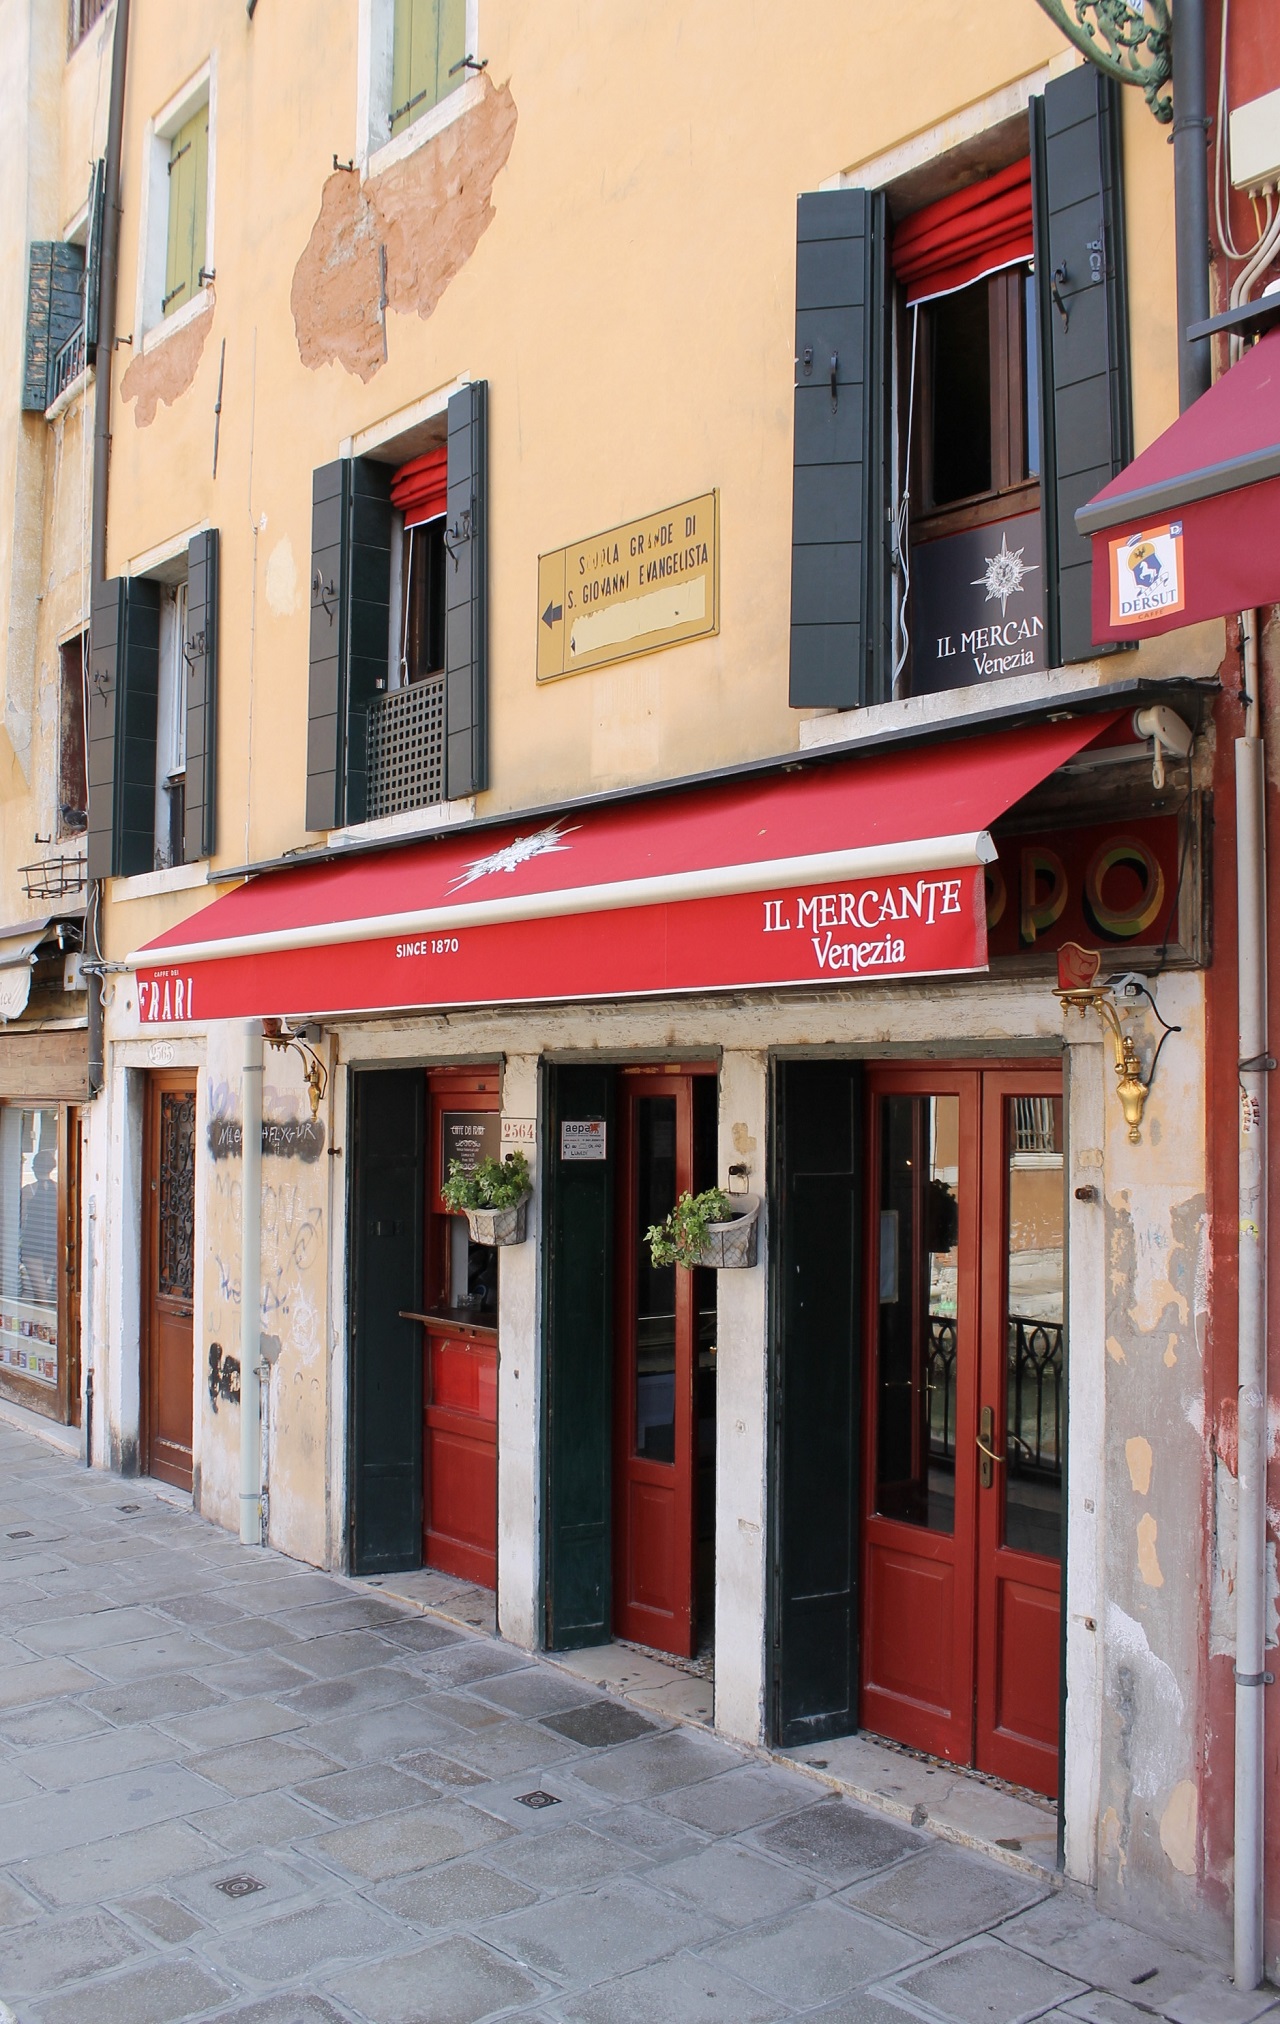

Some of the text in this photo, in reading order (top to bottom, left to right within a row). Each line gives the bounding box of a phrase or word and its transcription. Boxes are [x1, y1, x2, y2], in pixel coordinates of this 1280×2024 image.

[579, 543, 619, 575] SUOLA
[685, 515, 696, 538] DI
[567, 543, 708, 609] S. GIOVANNI EVANGELISTA
[1121, 589, 1176, 614] DERSUT
[937, 616, 1044, 659] IL MERCAN
[973, 648, 1035, 675] Venezia
[762, 879, 962, 934] IL MERCANTE
[396, 938, 459, 958] SINCE 1870
[811, 931, 906, 972] Venezia
[138, 977, 193, 1021] FRARI
[504, 1123, 534, 1139] 2564
